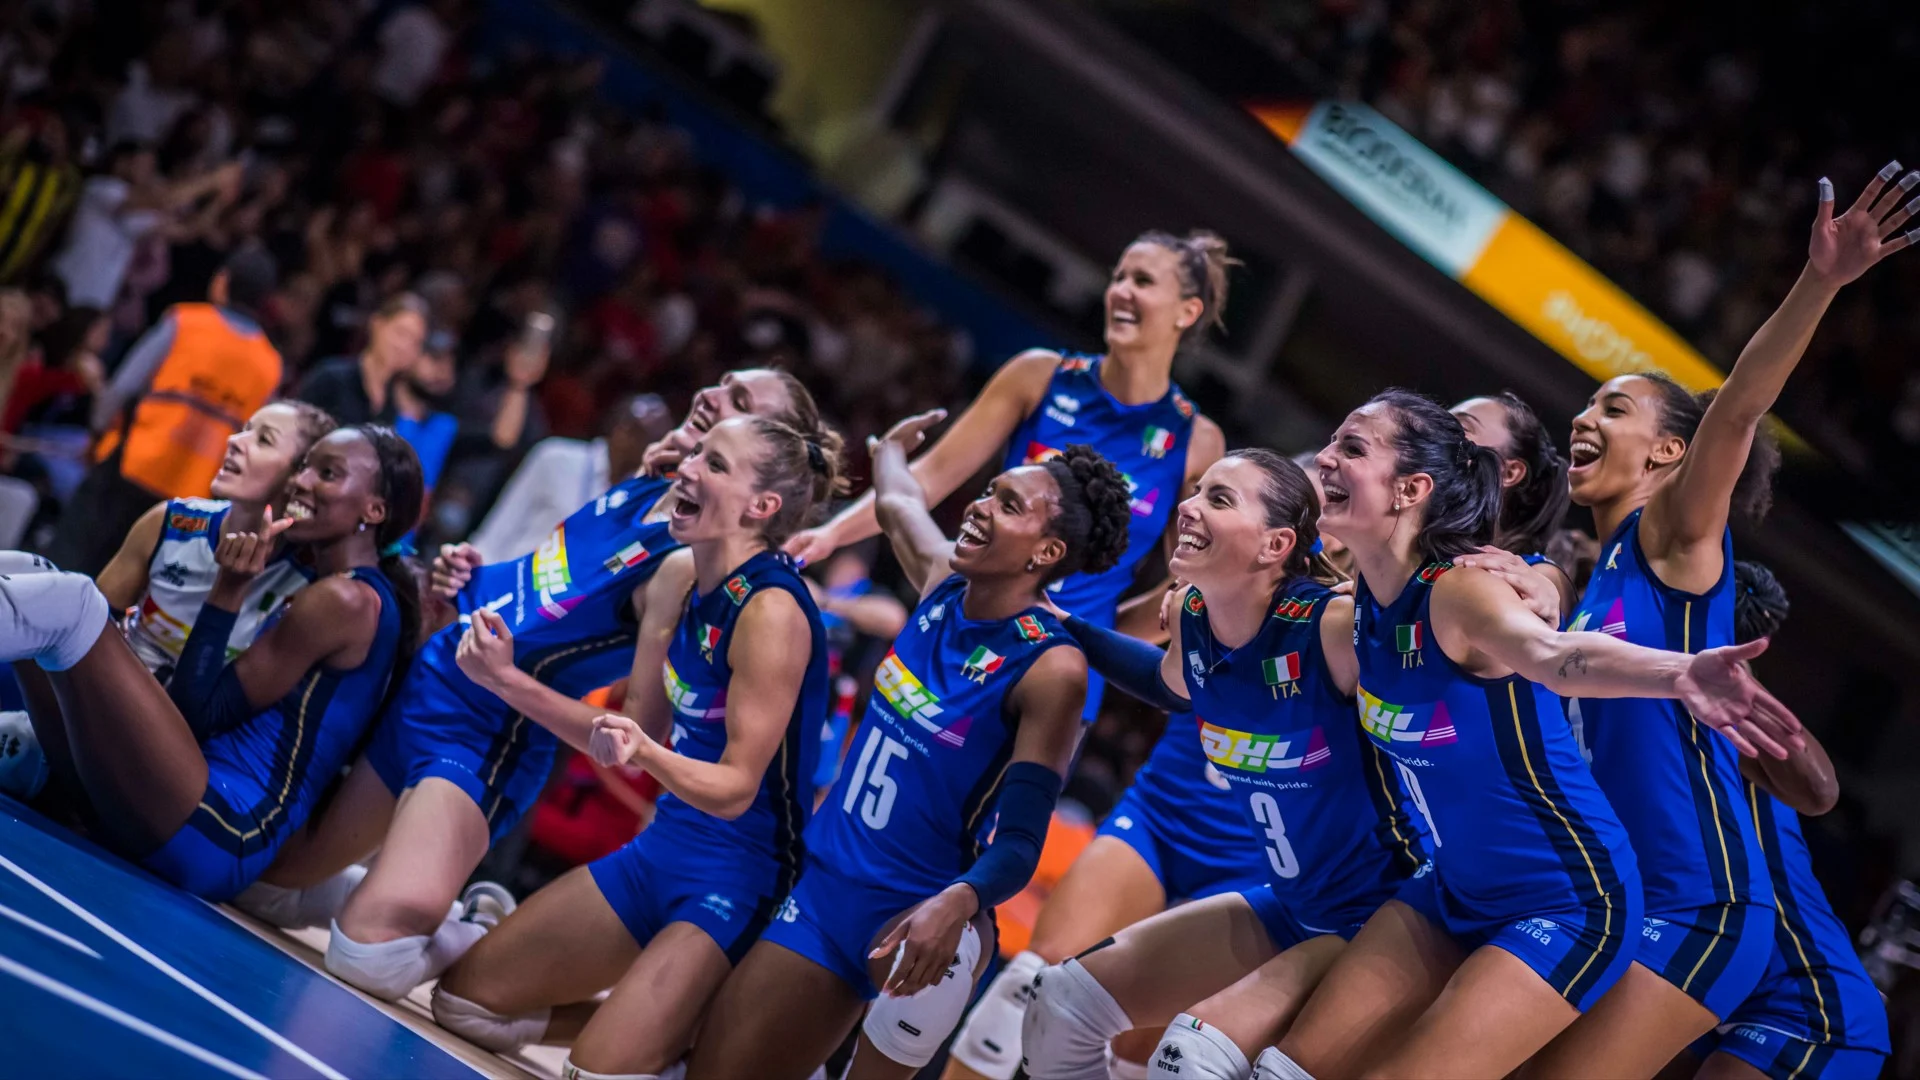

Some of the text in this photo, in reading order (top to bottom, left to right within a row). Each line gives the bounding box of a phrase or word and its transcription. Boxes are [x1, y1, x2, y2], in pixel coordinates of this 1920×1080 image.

[960, 662, 988, 686] ITA
[1402, 651, 1424, 669] ITA
[876, 658, 944, 734] DHL
[1271, 681, 1302, 700] ITA
[1200, 727, 1304, 769] DHL
[842, 725, 909, 830] 15
[1277, 779, 1313, 791] pride.
[1249, 791, 1300, 879] 3
